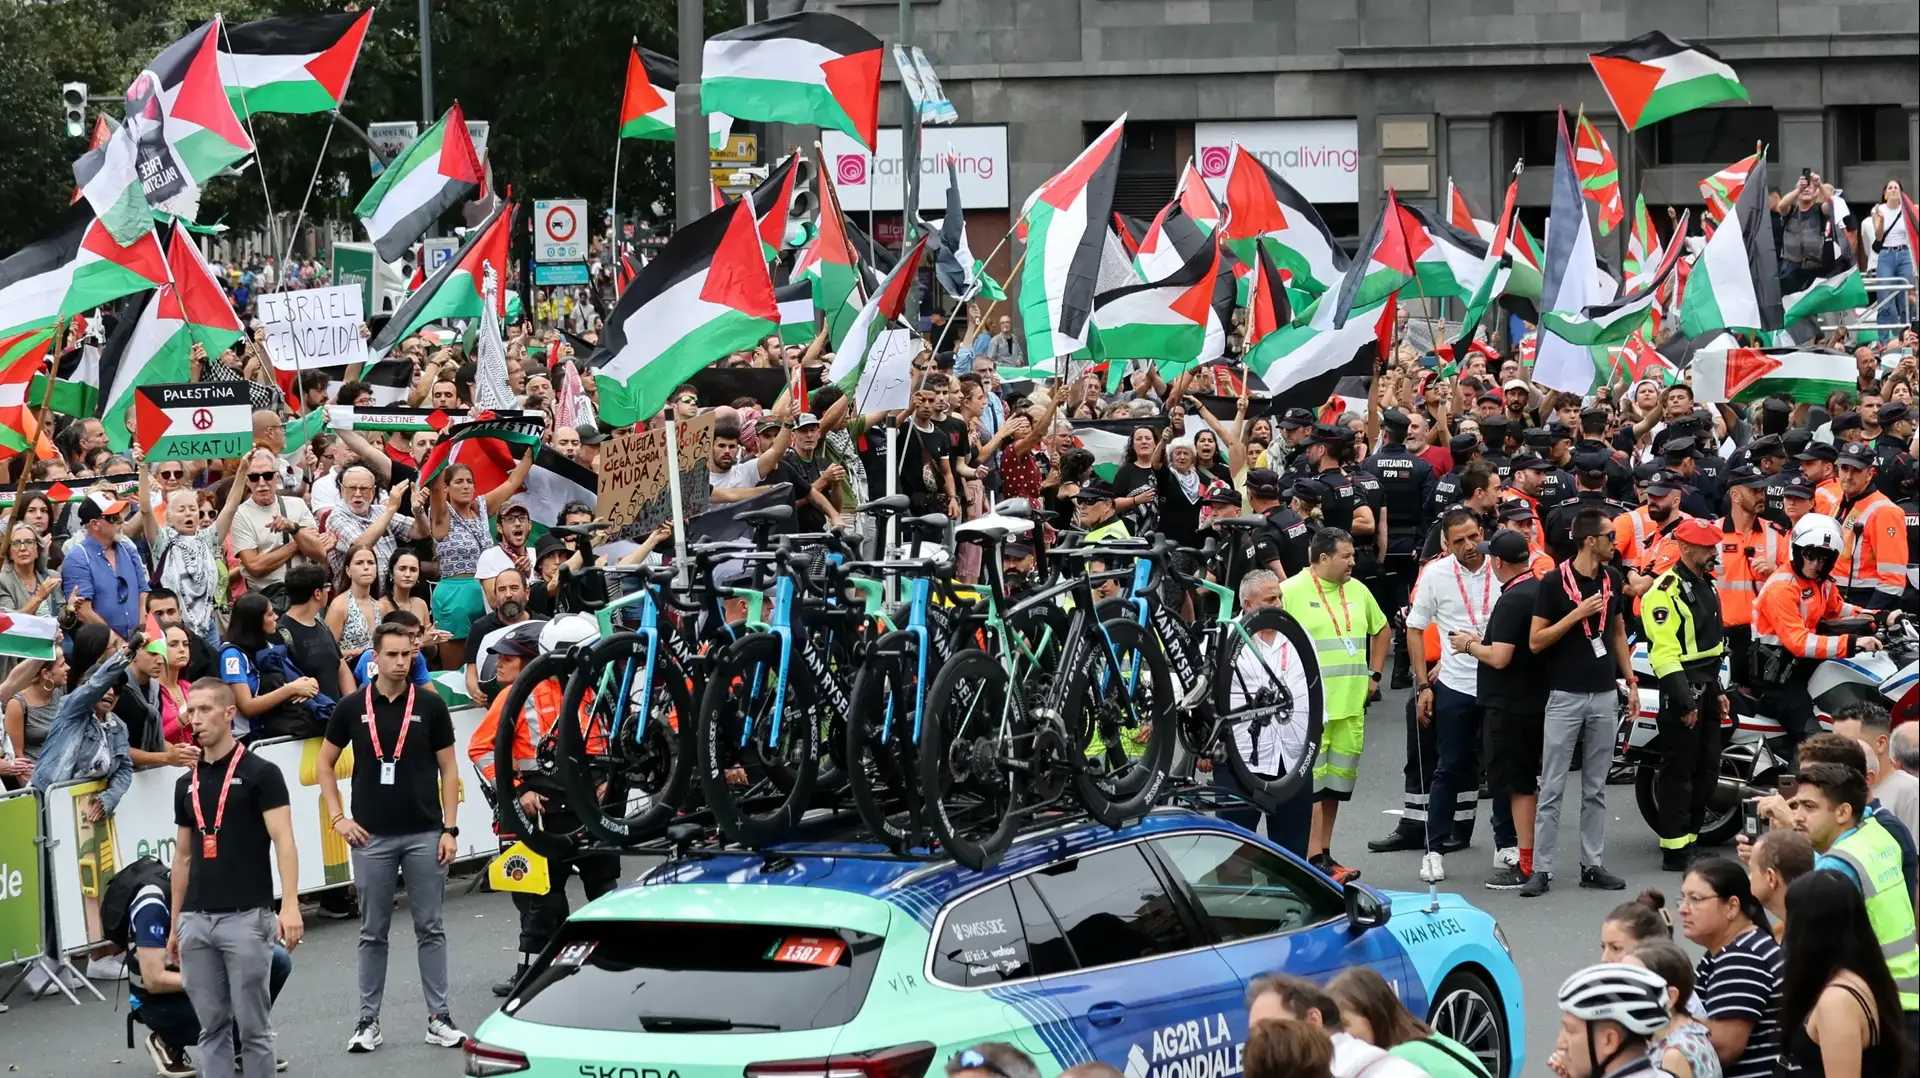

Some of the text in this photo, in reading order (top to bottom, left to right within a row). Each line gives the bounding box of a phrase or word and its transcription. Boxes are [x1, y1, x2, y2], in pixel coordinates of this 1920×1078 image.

[870, 153, 993, 180] faraliving
[1252, 146, 1358, 173] maliving
[265, 293, 356, 325] ISRAEL
[266, 323, 361, 362] GENOZIDA
[361, 415, 416, 424] PALESTINE
[167, 437, 242, 456] ASKATU!
[606, 444, 619, 458] LA
[612, 463, 649, 490] MUDA
[1377, 459, 1413, 468] ERTZAINTZA
[1154, 603, 1196, 689] VAN RYSEL
[802, 639, 850, 722] VAN RYSEL
[1399, 917, 1466, 945] VAN RYSEL
[1152, 1012, 1231, 1063] AG2R LA
